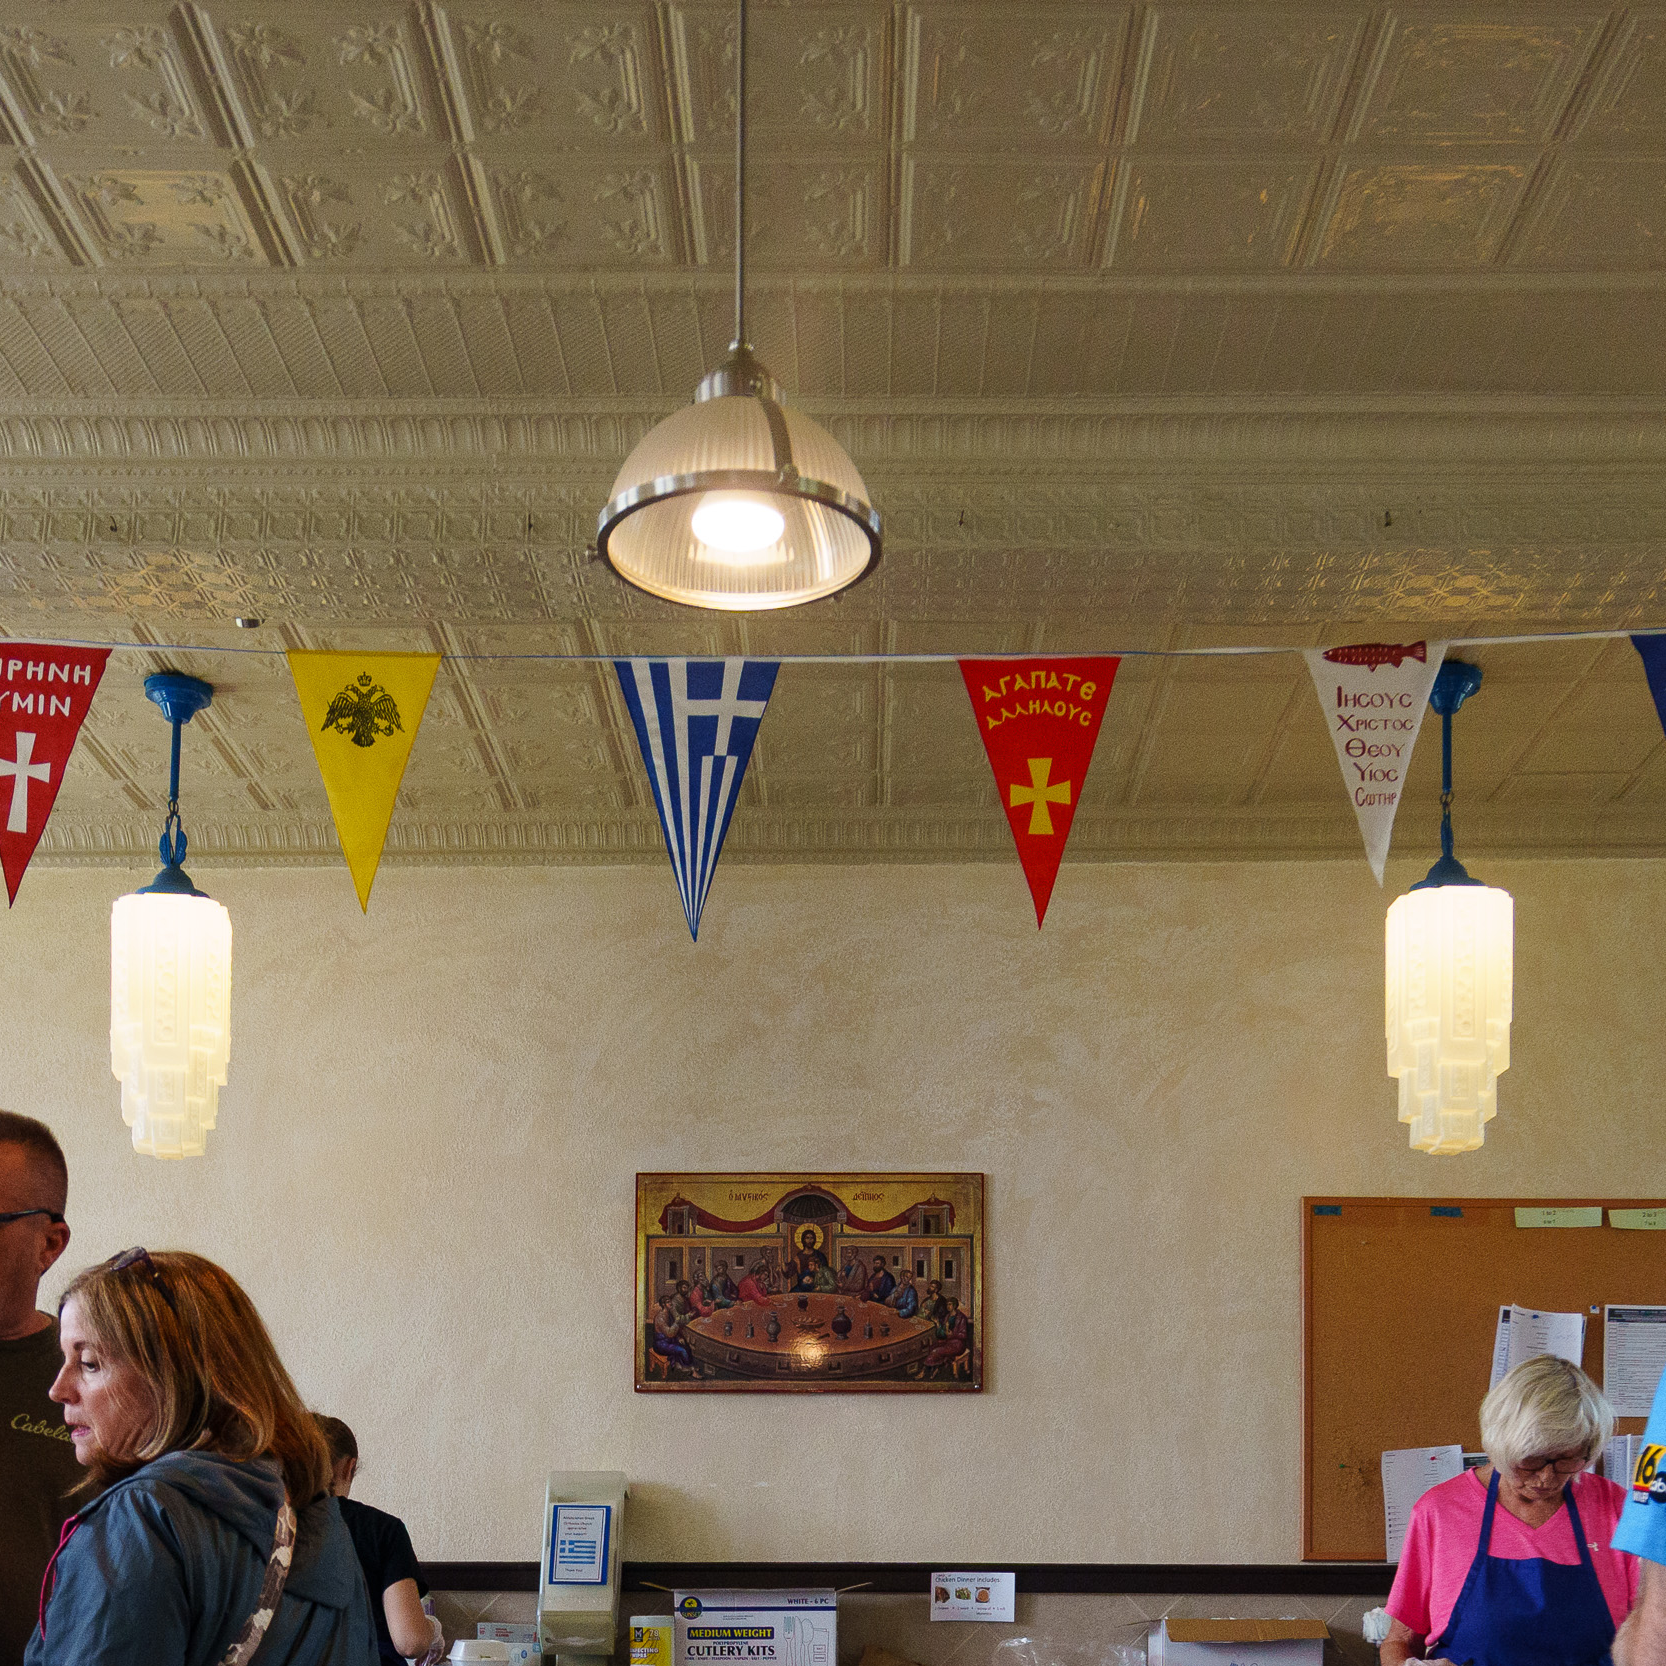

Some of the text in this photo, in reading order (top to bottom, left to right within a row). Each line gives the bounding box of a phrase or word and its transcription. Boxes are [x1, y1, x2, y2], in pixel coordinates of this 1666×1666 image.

[10, 1412, 72, 1443] Cabela
[1635, 1445, 1663, 1485] 16
[689, 1628, 773, 1638] MEDIUM WEIGHT
[687, 1645, 775, 1656] CUTLERY KITS
